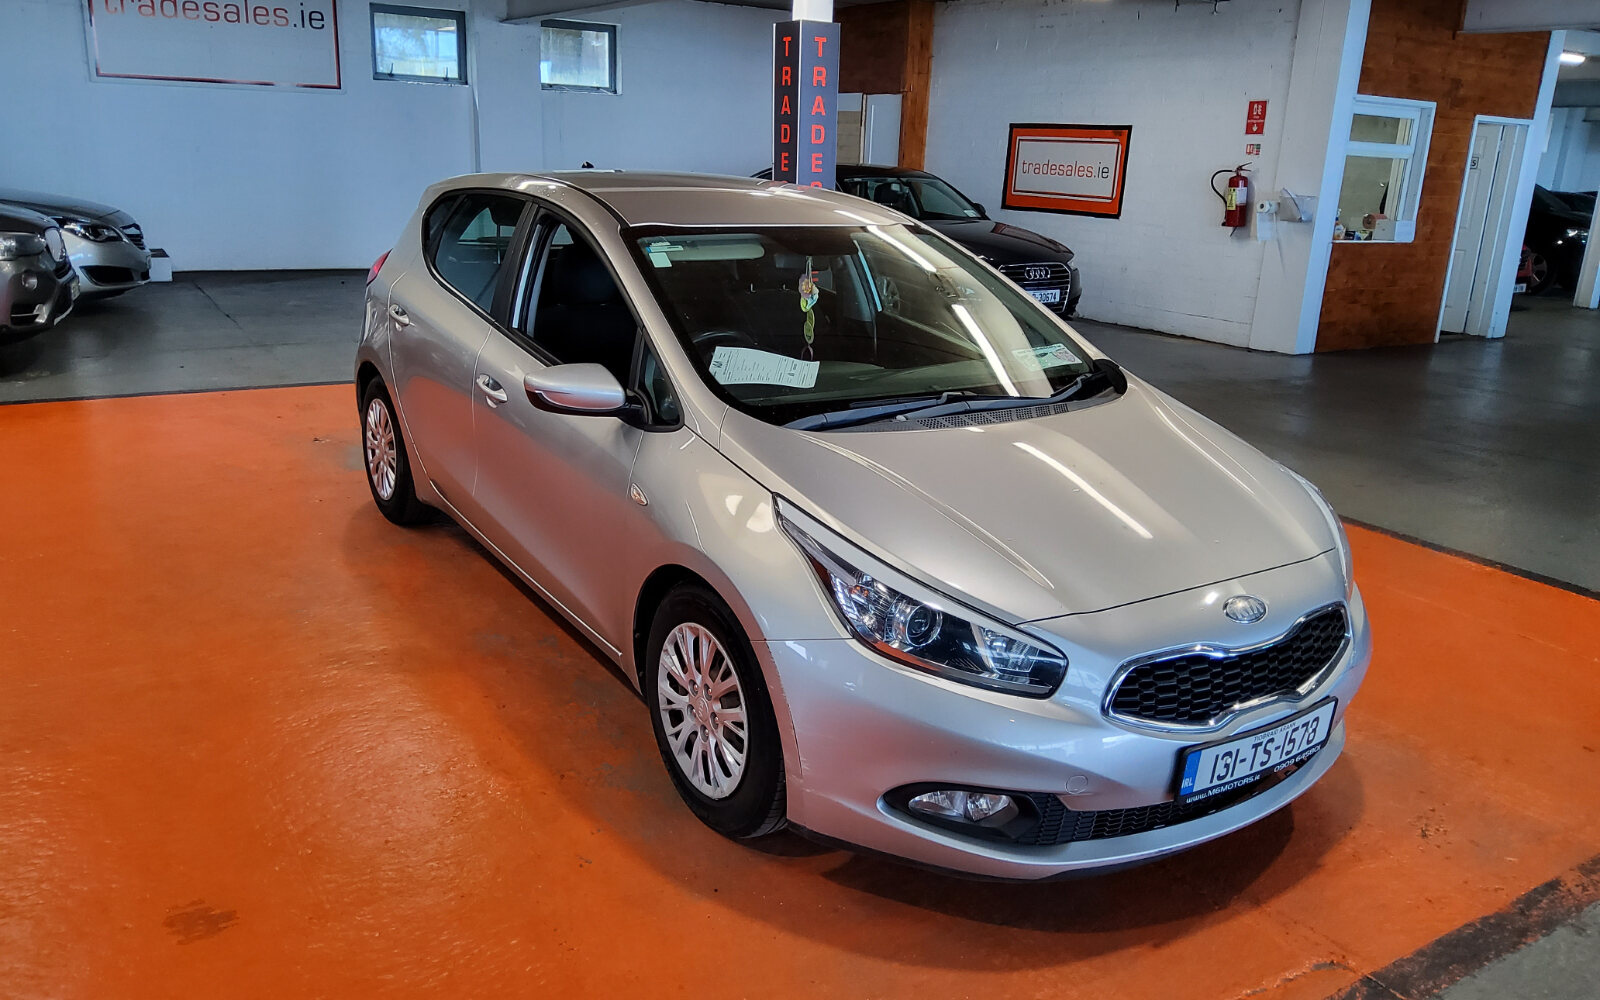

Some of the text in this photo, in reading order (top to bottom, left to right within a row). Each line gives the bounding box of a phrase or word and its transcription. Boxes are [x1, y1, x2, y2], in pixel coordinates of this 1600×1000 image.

[780, 36, 792, 184] TRADE
[1022, 160, 1110, 179] tradesales.ie
[1209, 715, 1320, 784] 131-TS-1578
[1181, 778, 1194, 789] IRL
